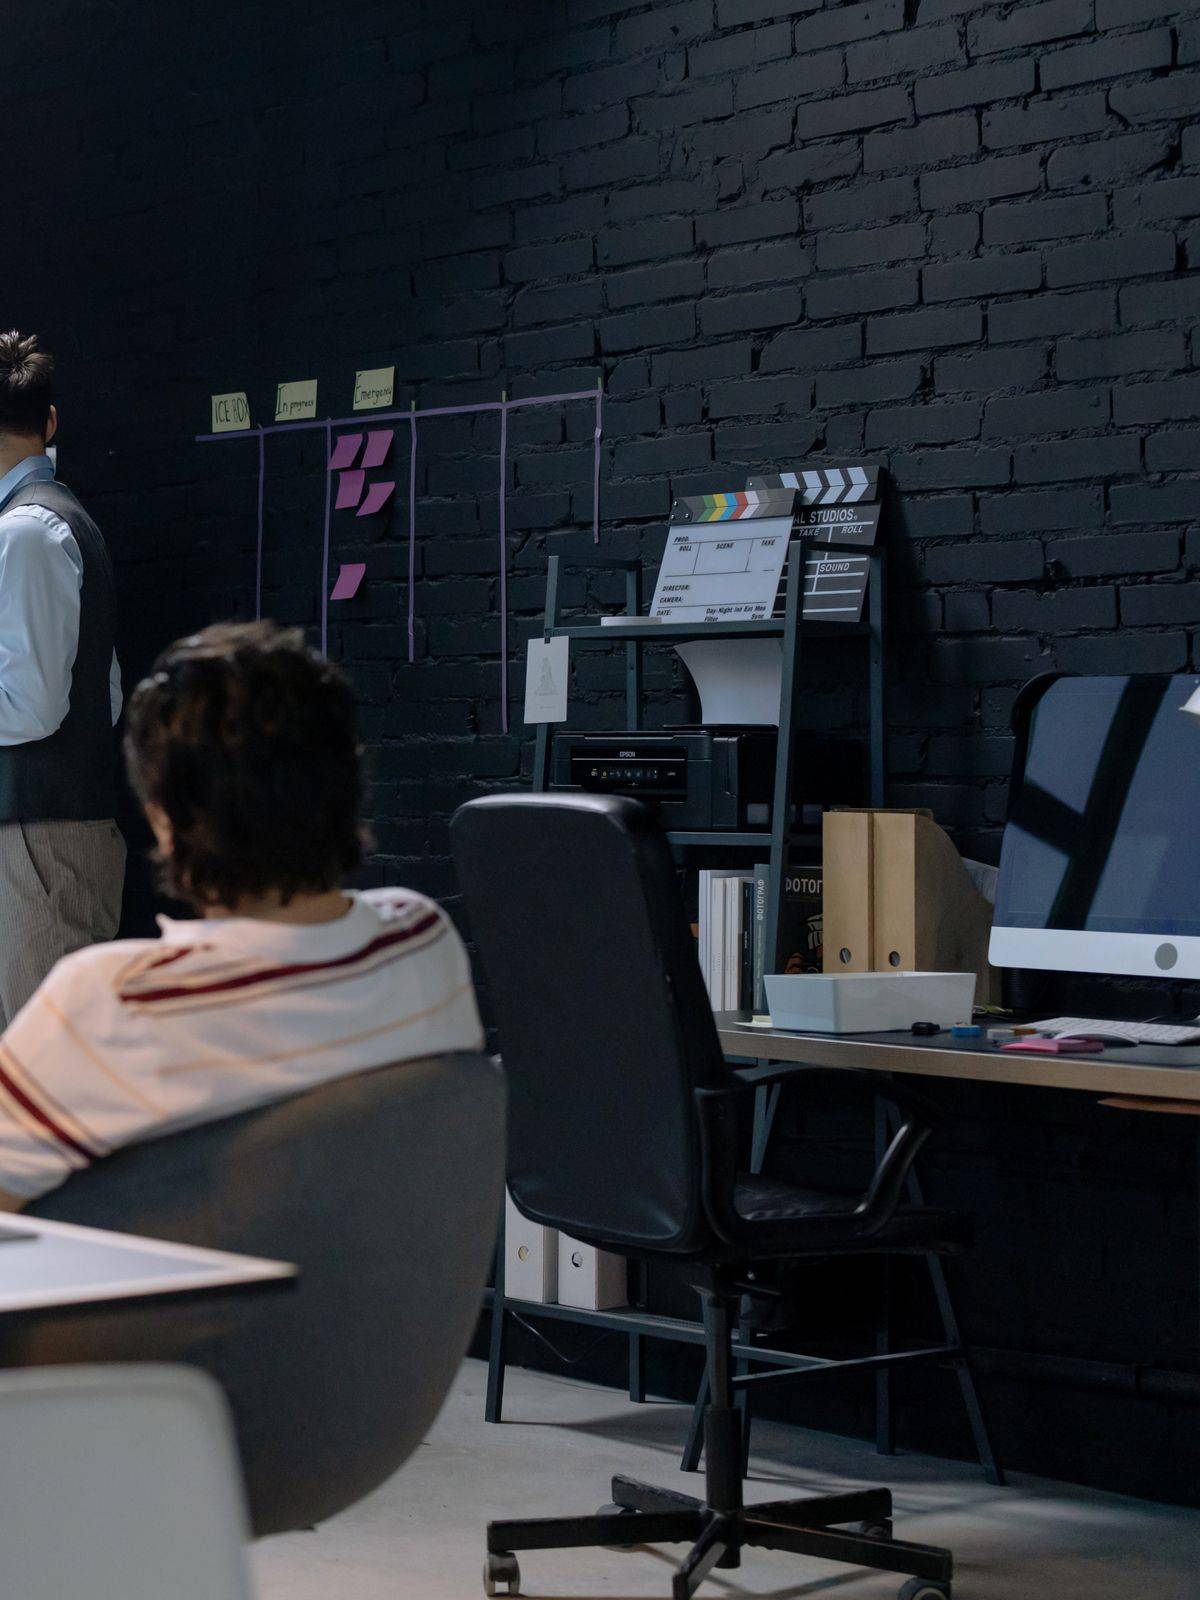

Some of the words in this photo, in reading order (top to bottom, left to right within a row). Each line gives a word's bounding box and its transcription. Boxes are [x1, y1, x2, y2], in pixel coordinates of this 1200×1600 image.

[275, 384, 288, 416] In
[290, 400, 314, 416] progress
[215, 399, 231, 423] ICE
[232, 397, 249, 423] BOX
[799, 528, 820, 537] TAKE
[841, 525, 863, 534] ROLL
[715, 542, 735, 550] SCENE
[819, 562, 850, 573] SOUND
[619, 750, 636, 758] EPSON
[756, 878, 765, 921] ФОТОГРАФ
